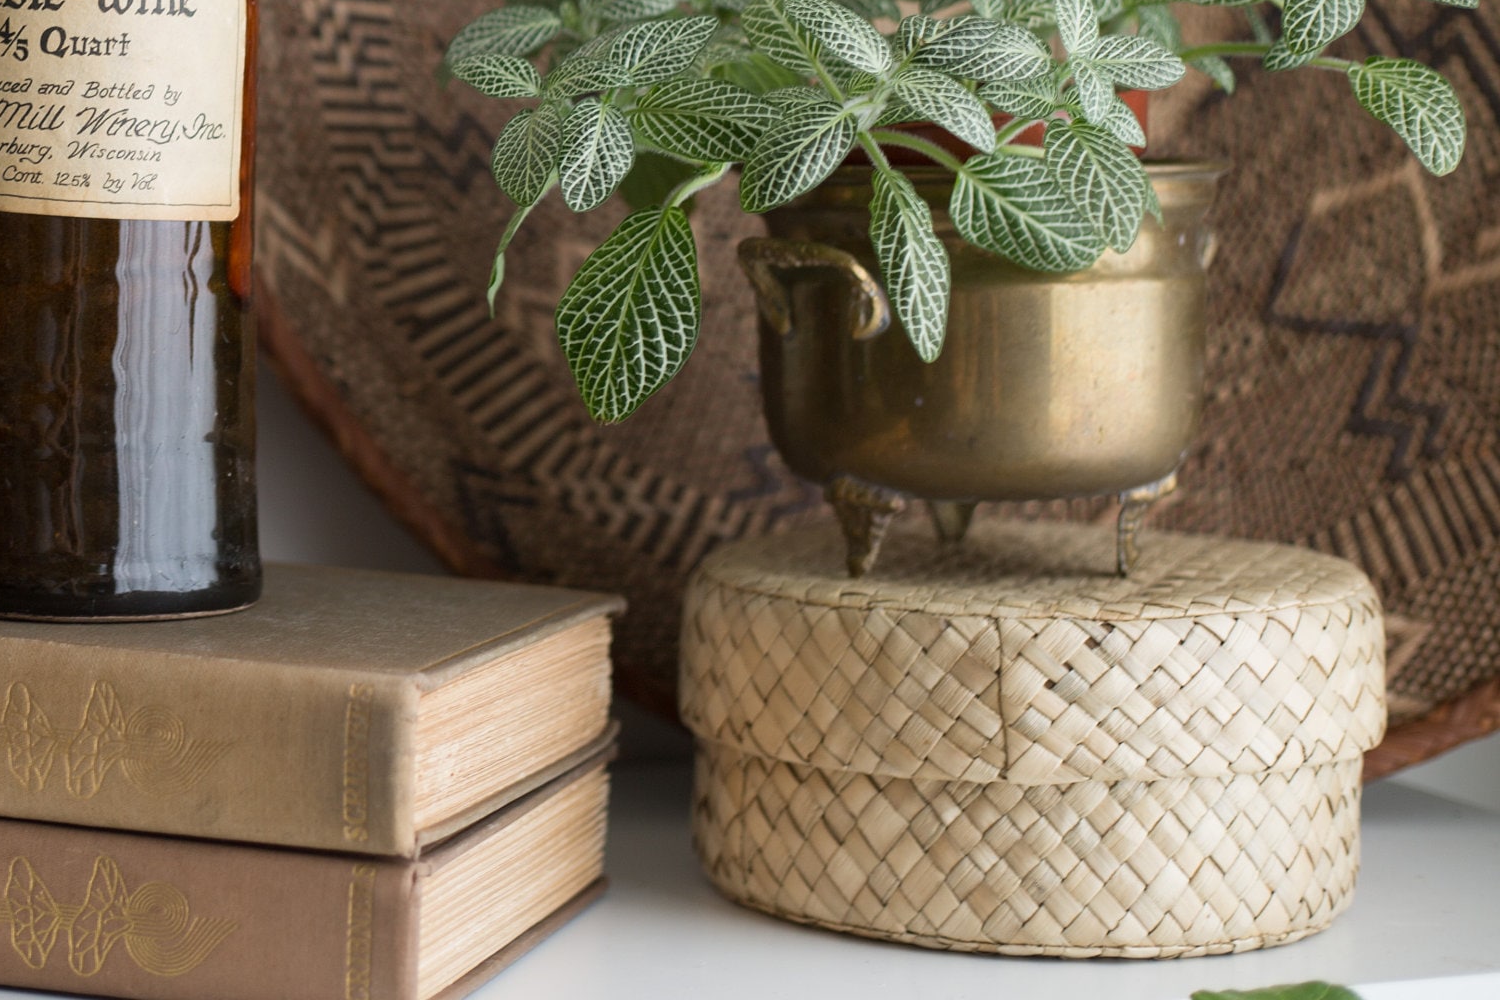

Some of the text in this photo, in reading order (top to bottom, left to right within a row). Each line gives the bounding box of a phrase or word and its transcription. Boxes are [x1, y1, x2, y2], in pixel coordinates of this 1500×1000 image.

[40, 26, 131, 58] Quart
[37, 79, 75, 97] and
[80, 81, 155, 100] Bottled
[163, 85, 183, 105] by
[182, 112, 227, 141] Inc.
[67, 141, 162, 163] Wisconsin
[2, 165, 44, 185] Cont.
[102, 172, 124, 193] by
